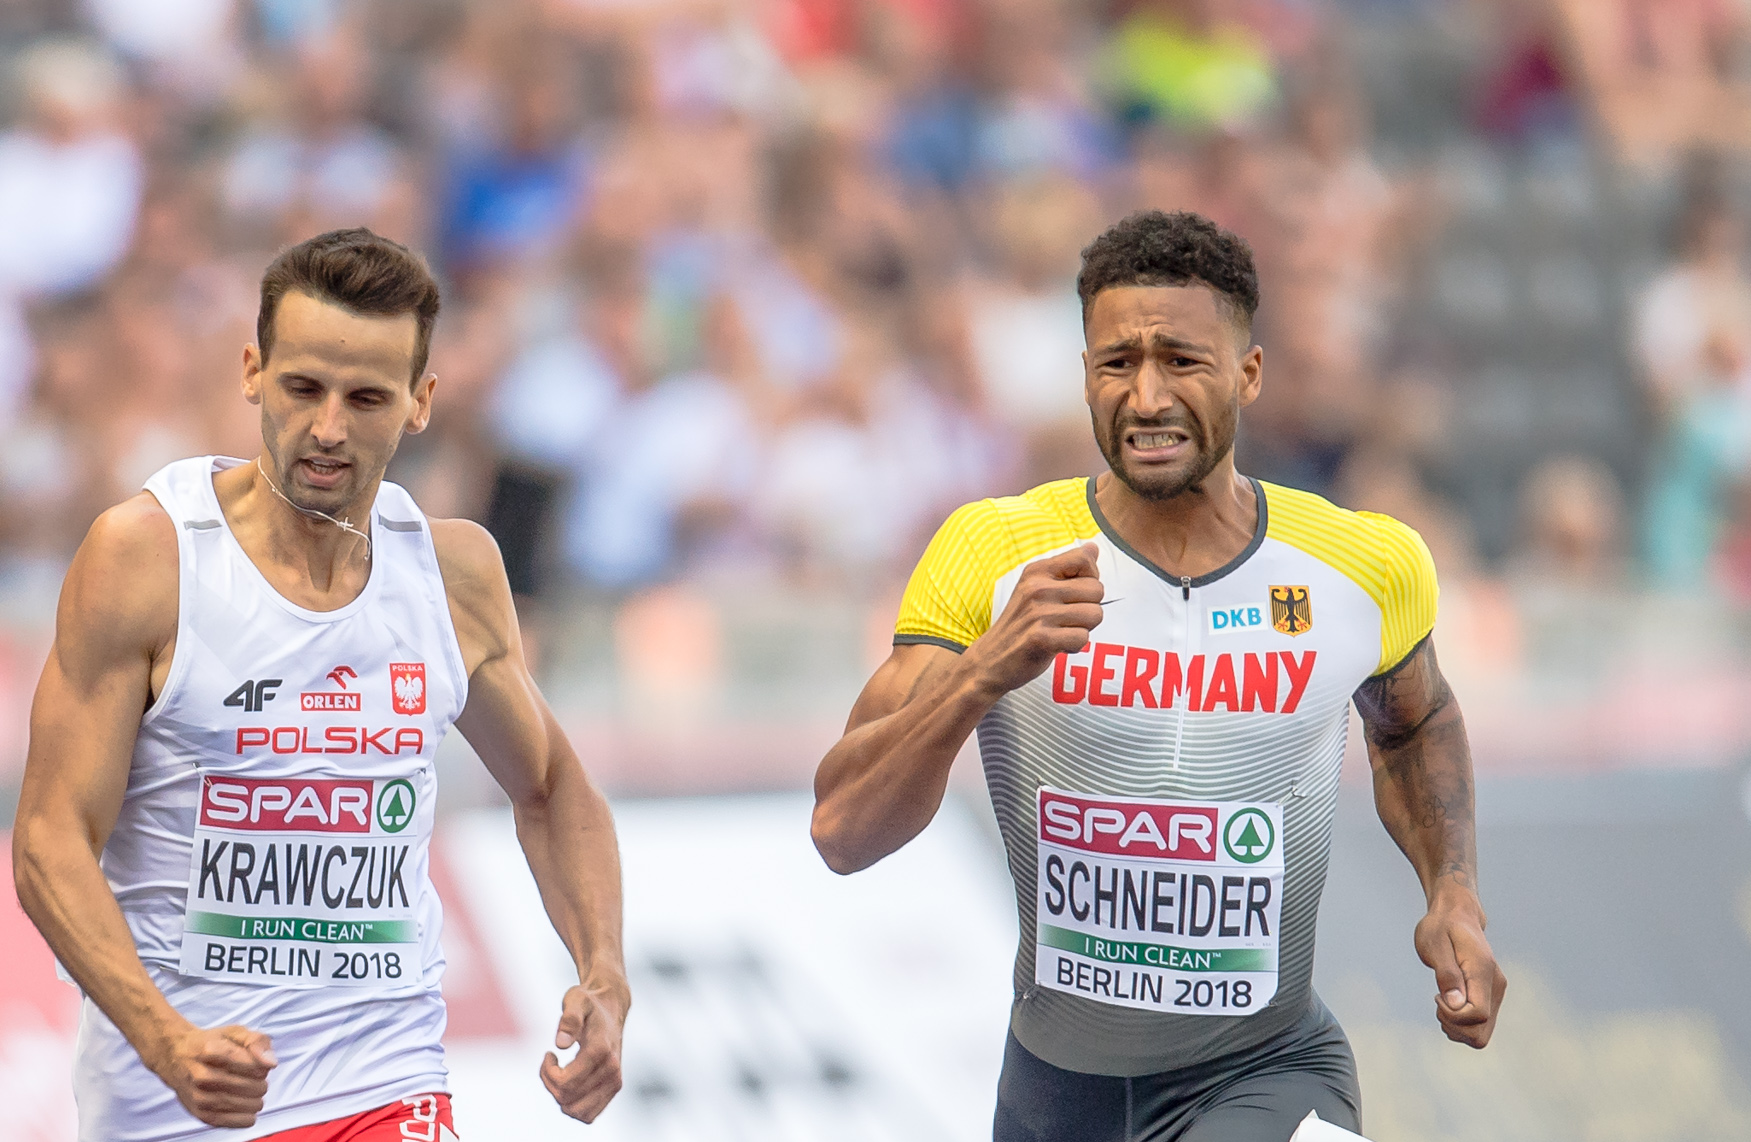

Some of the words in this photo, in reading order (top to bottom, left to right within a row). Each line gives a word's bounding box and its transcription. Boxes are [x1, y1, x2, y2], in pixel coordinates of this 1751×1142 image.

[1211, 606, 1262, 631] DKB
[223, 678, 283, 712] 4F
[1051, 641, 1317, 714] GERMANY
[302, 694, 357, 710] ORLEN
[236, 726, 423, 755] POLSKA
[205, 784, 368, 826] SPAR
[1044, 801, 1214, 853] SPAR
[197, 838, 410, 909] KRAWCZUK
[1044, 854, 1272, 938] SCHNEIDER
[240, 919, 246, 936] I
[252, 920, 295, 937] RUN
[204, 942, 321, 978] BERLIN
[331, 951, 403, 980] 2018
[1084, 936, 1090, 953] I
[1094, 938, 1138, 962] RUN
[1056, 957, 1164, 1004] BERLIN
[1174, 978, 1252, 1008] 2018
